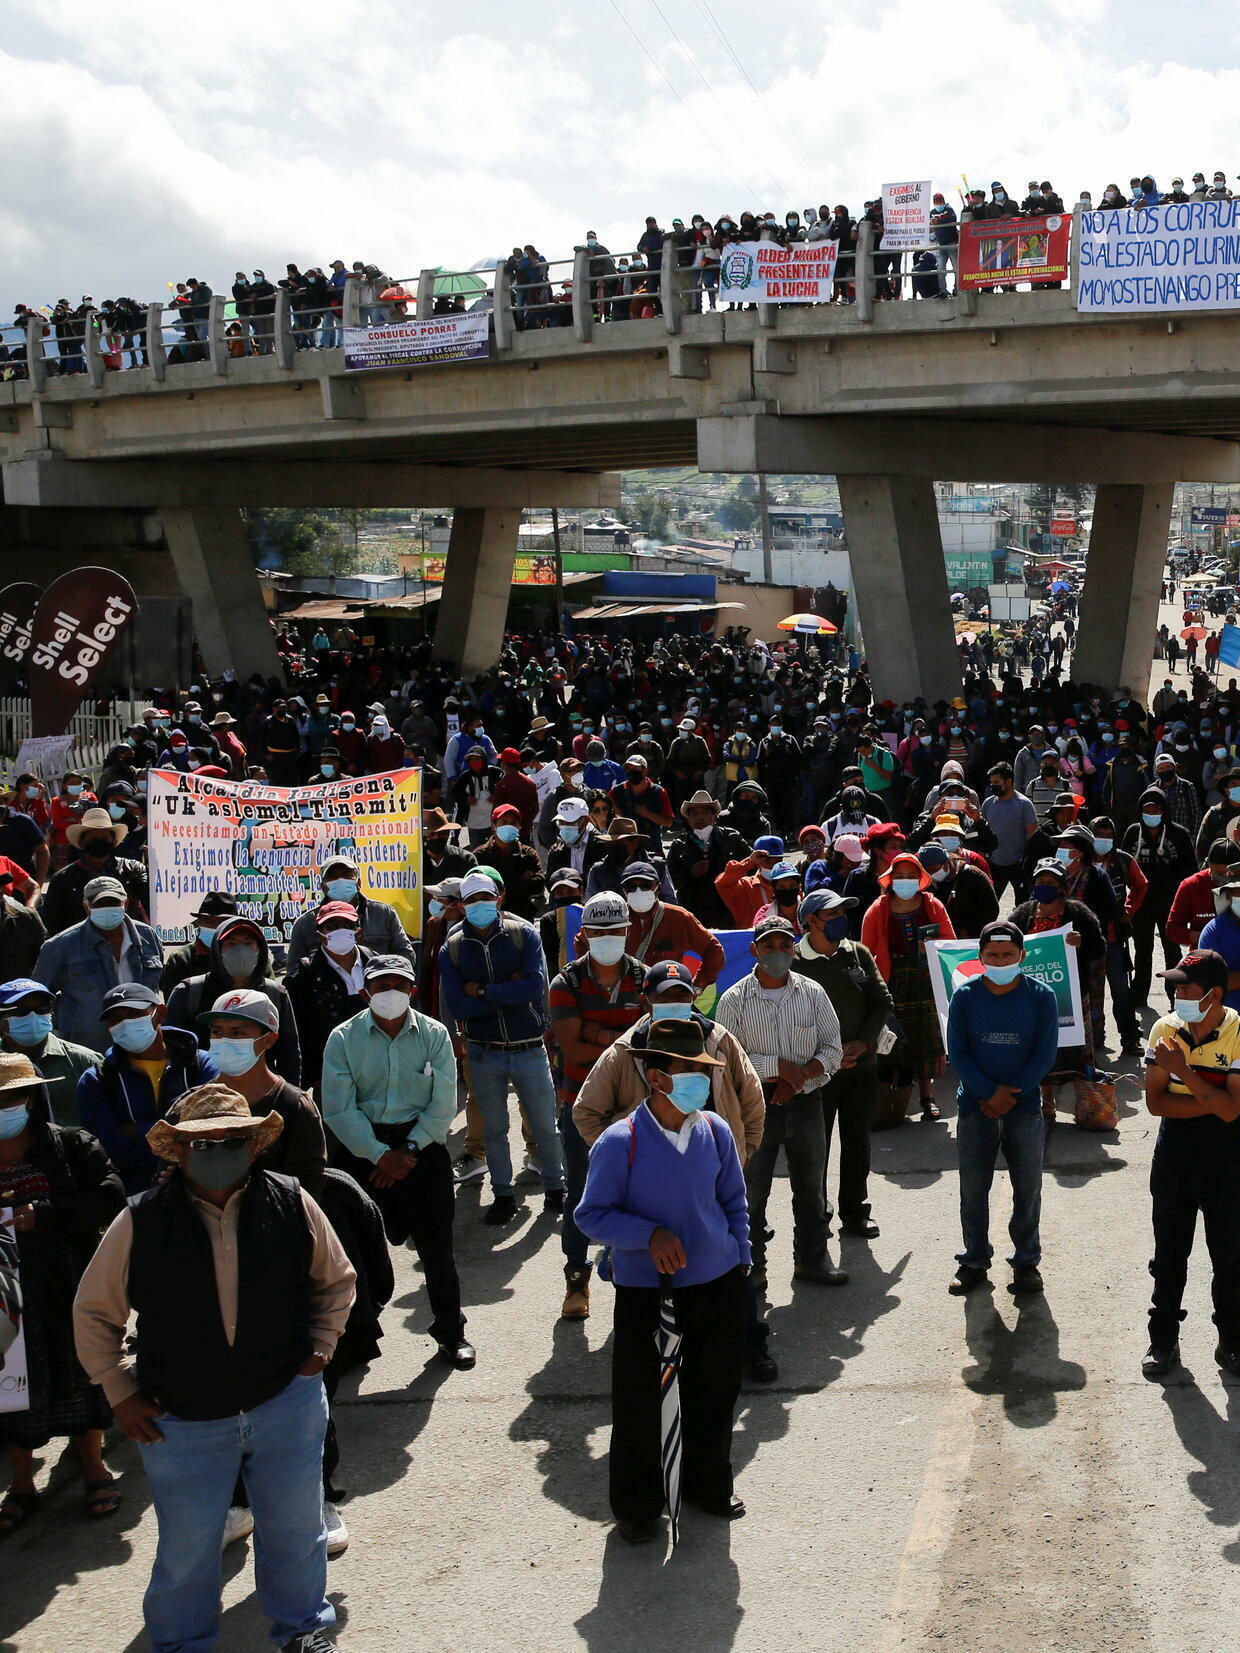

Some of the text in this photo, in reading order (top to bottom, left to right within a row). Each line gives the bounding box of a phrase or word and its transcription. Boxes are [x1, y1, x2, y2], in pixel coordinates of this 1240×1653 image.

[1081, 211, 1105, 234] NO
[1106, 211, 1121, 235] A
[1126, 207, 1159, 235] LOS
[756, 248, 791, 263] ALDEA
[1080, 241, 1095, 266] SI
[1116, 239, 1179, 267] ESTADO
[758, 264, 830, 279] PRESENTE EN
[766, 281, 819, 297] LA LUCHA
[1079, 274, 1211, 306] MOMOSTENANGO
[368, 323, 457, 341] CONSUELO PORRAS
[32, 611, 81, 670] Shell
[58, 595, 132, 687] Select
[287, 776, 396, 801] Indígena
[251, 826, 269, 840] un
[274, 823, 319, 840] Estado
[174, 841, 230, 872] Exigimos
[236, 845, 250, 868] la
[316, 845, 336, 865] del
[155, 865, 418, 898] Alejandro Giammattei, la Consuelo
[236, 901, 262, 921] rras
[267, 901, 275, 925] y
[280, 901, 301, 920] sus
[590, 905, 623, 919] New York
[1020, 961, 1062, 974] NSEJO DEL
[223, 996, 242, 1010] P
